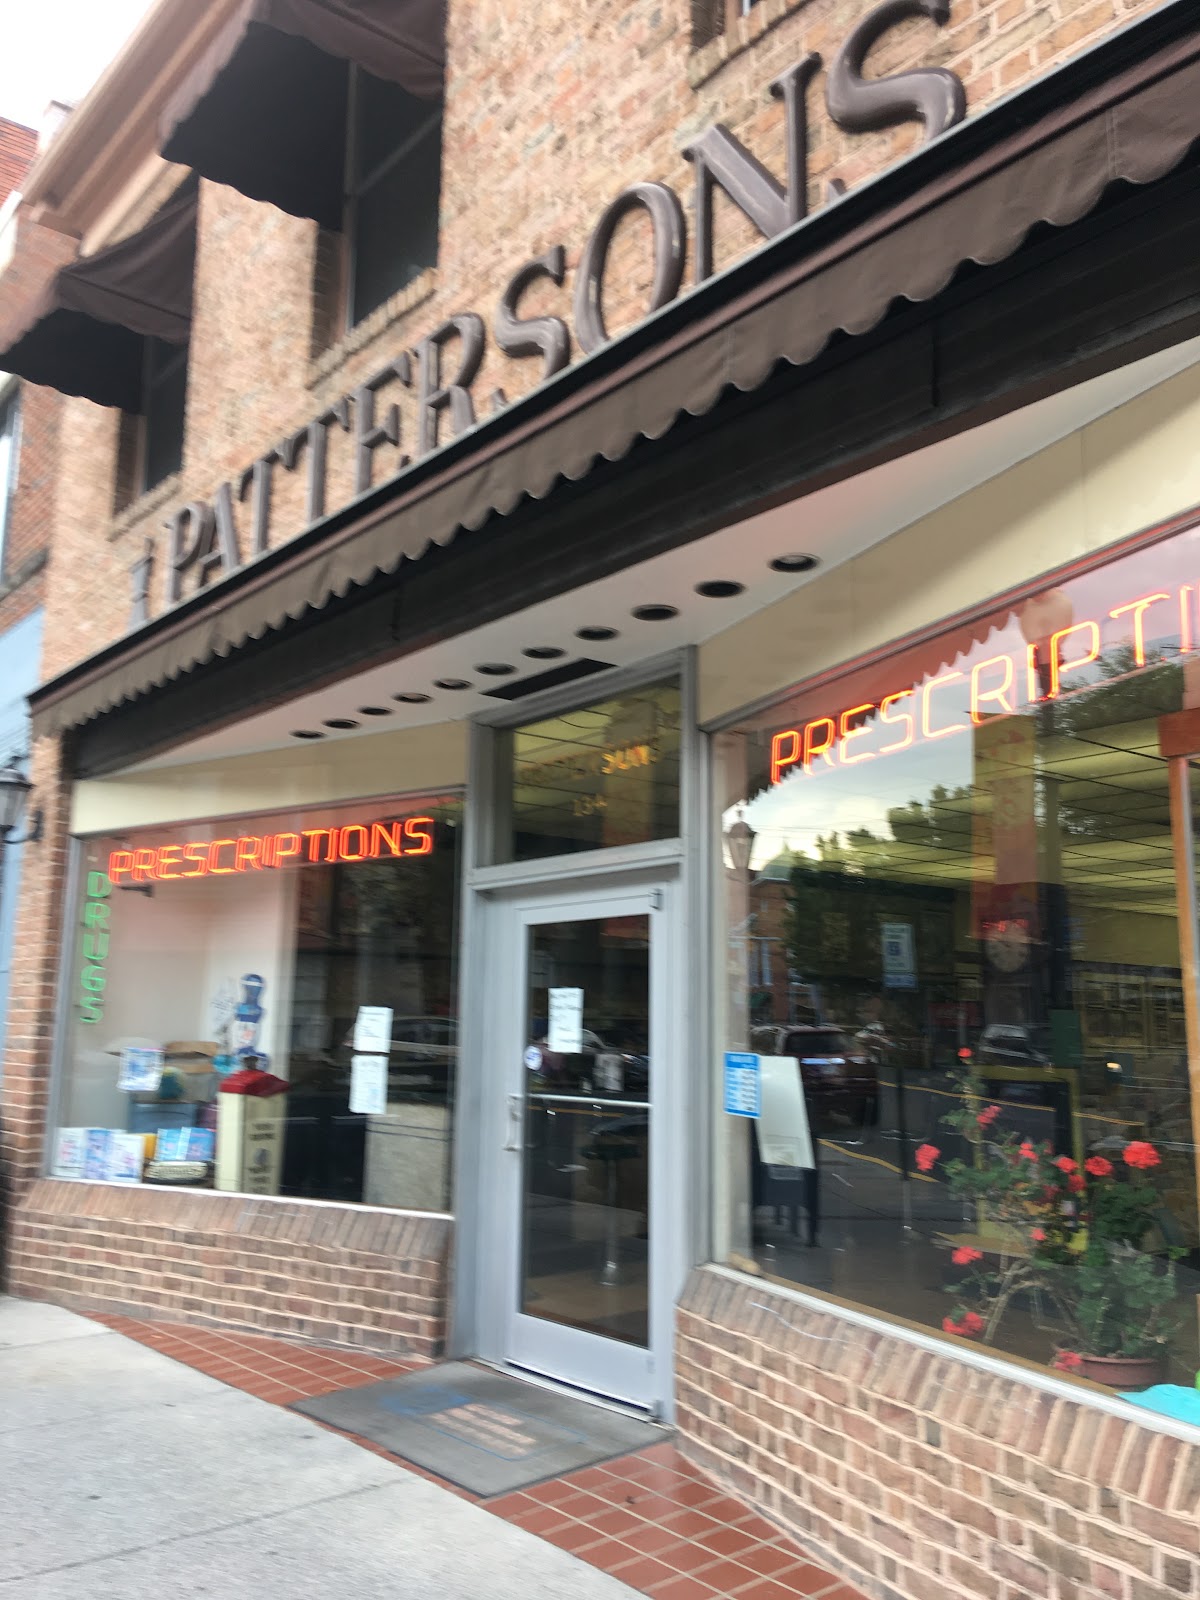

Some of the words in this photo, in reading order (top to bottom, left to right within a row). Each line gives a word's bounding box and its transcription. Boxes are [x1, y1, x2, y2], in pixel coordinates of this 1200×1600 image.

[162, 0, 967, 605] PATTERSONS
[771, 582, 1200, 785] PRESCRIPTI
[108, 816, 435, 884] PRESCRIPTIONS
[79, 870, 113, 1024] DRUGS
